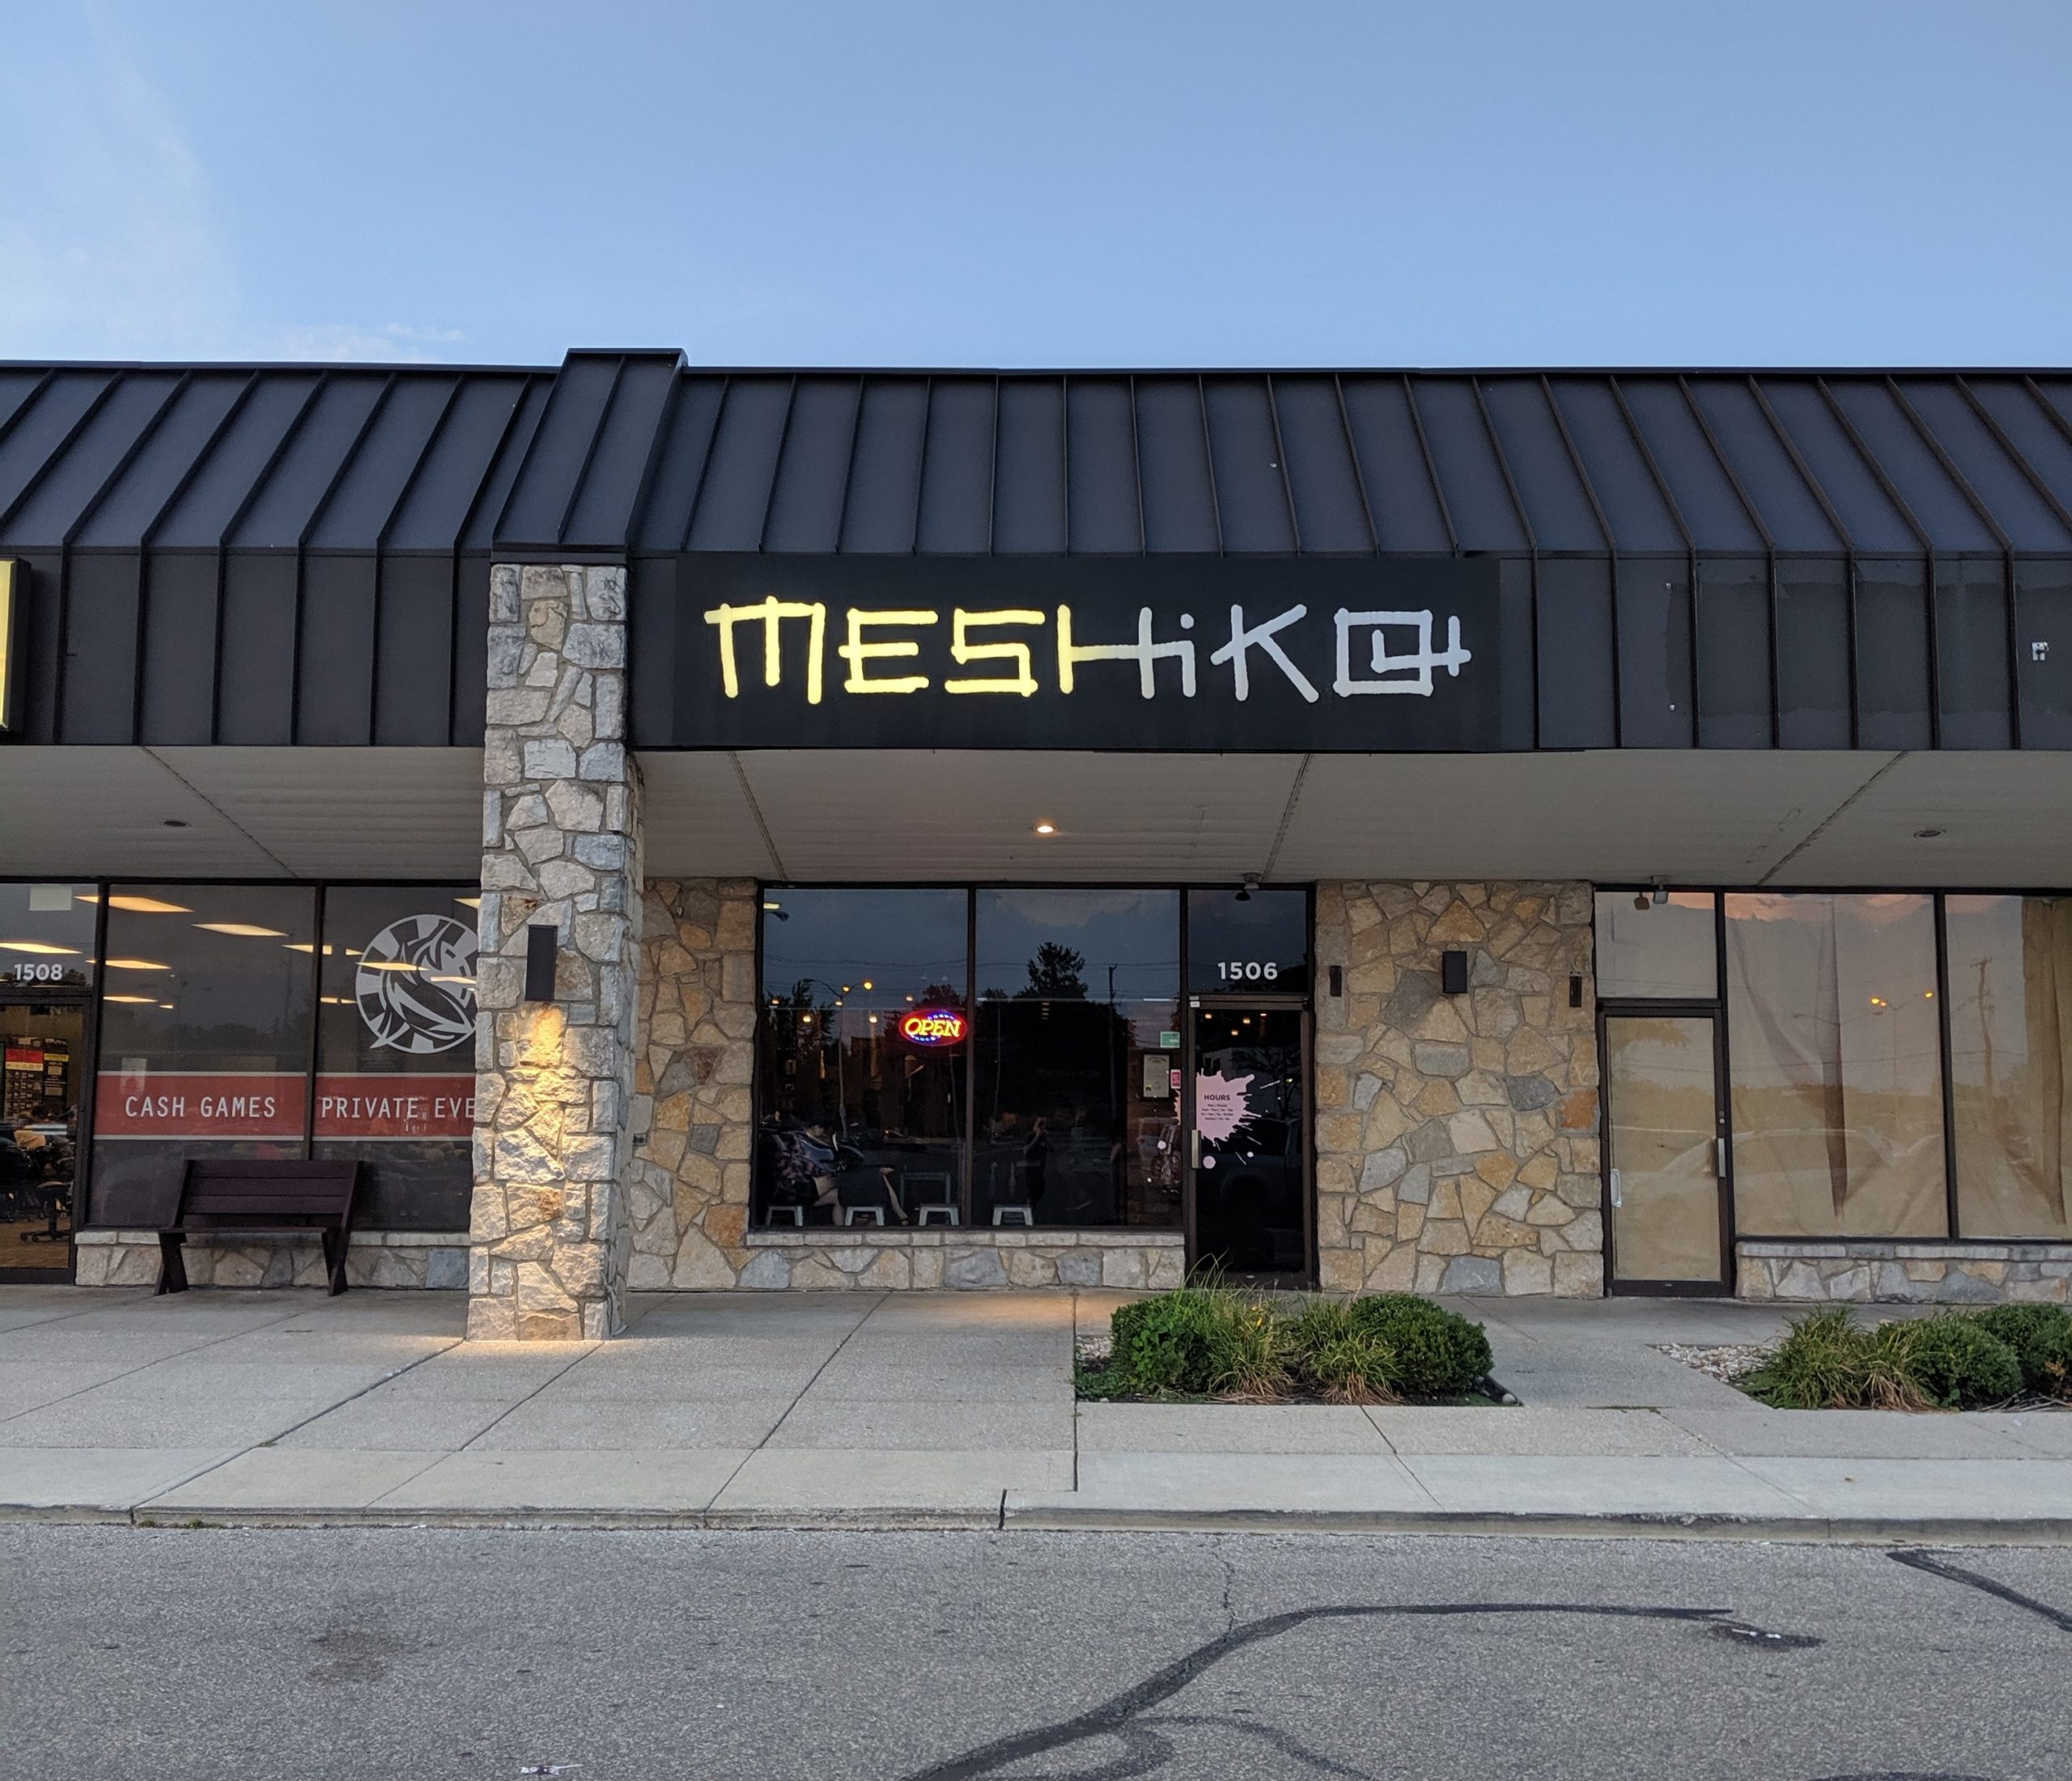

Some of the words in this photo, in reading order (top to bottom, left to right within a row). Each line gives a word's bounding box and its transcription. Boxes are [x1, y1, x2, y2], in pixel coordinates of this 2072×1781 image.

[14, 963, 63, 982] 1508
[1217, 962, 1278, 980] 1506
[904, 1017, 962, 1037] OPEN
[125, 1096, 185, 1117] CASH
[200, 1096, 276, 1117] GAMES
[321, 1097, 418, 1118] PRIVATE
